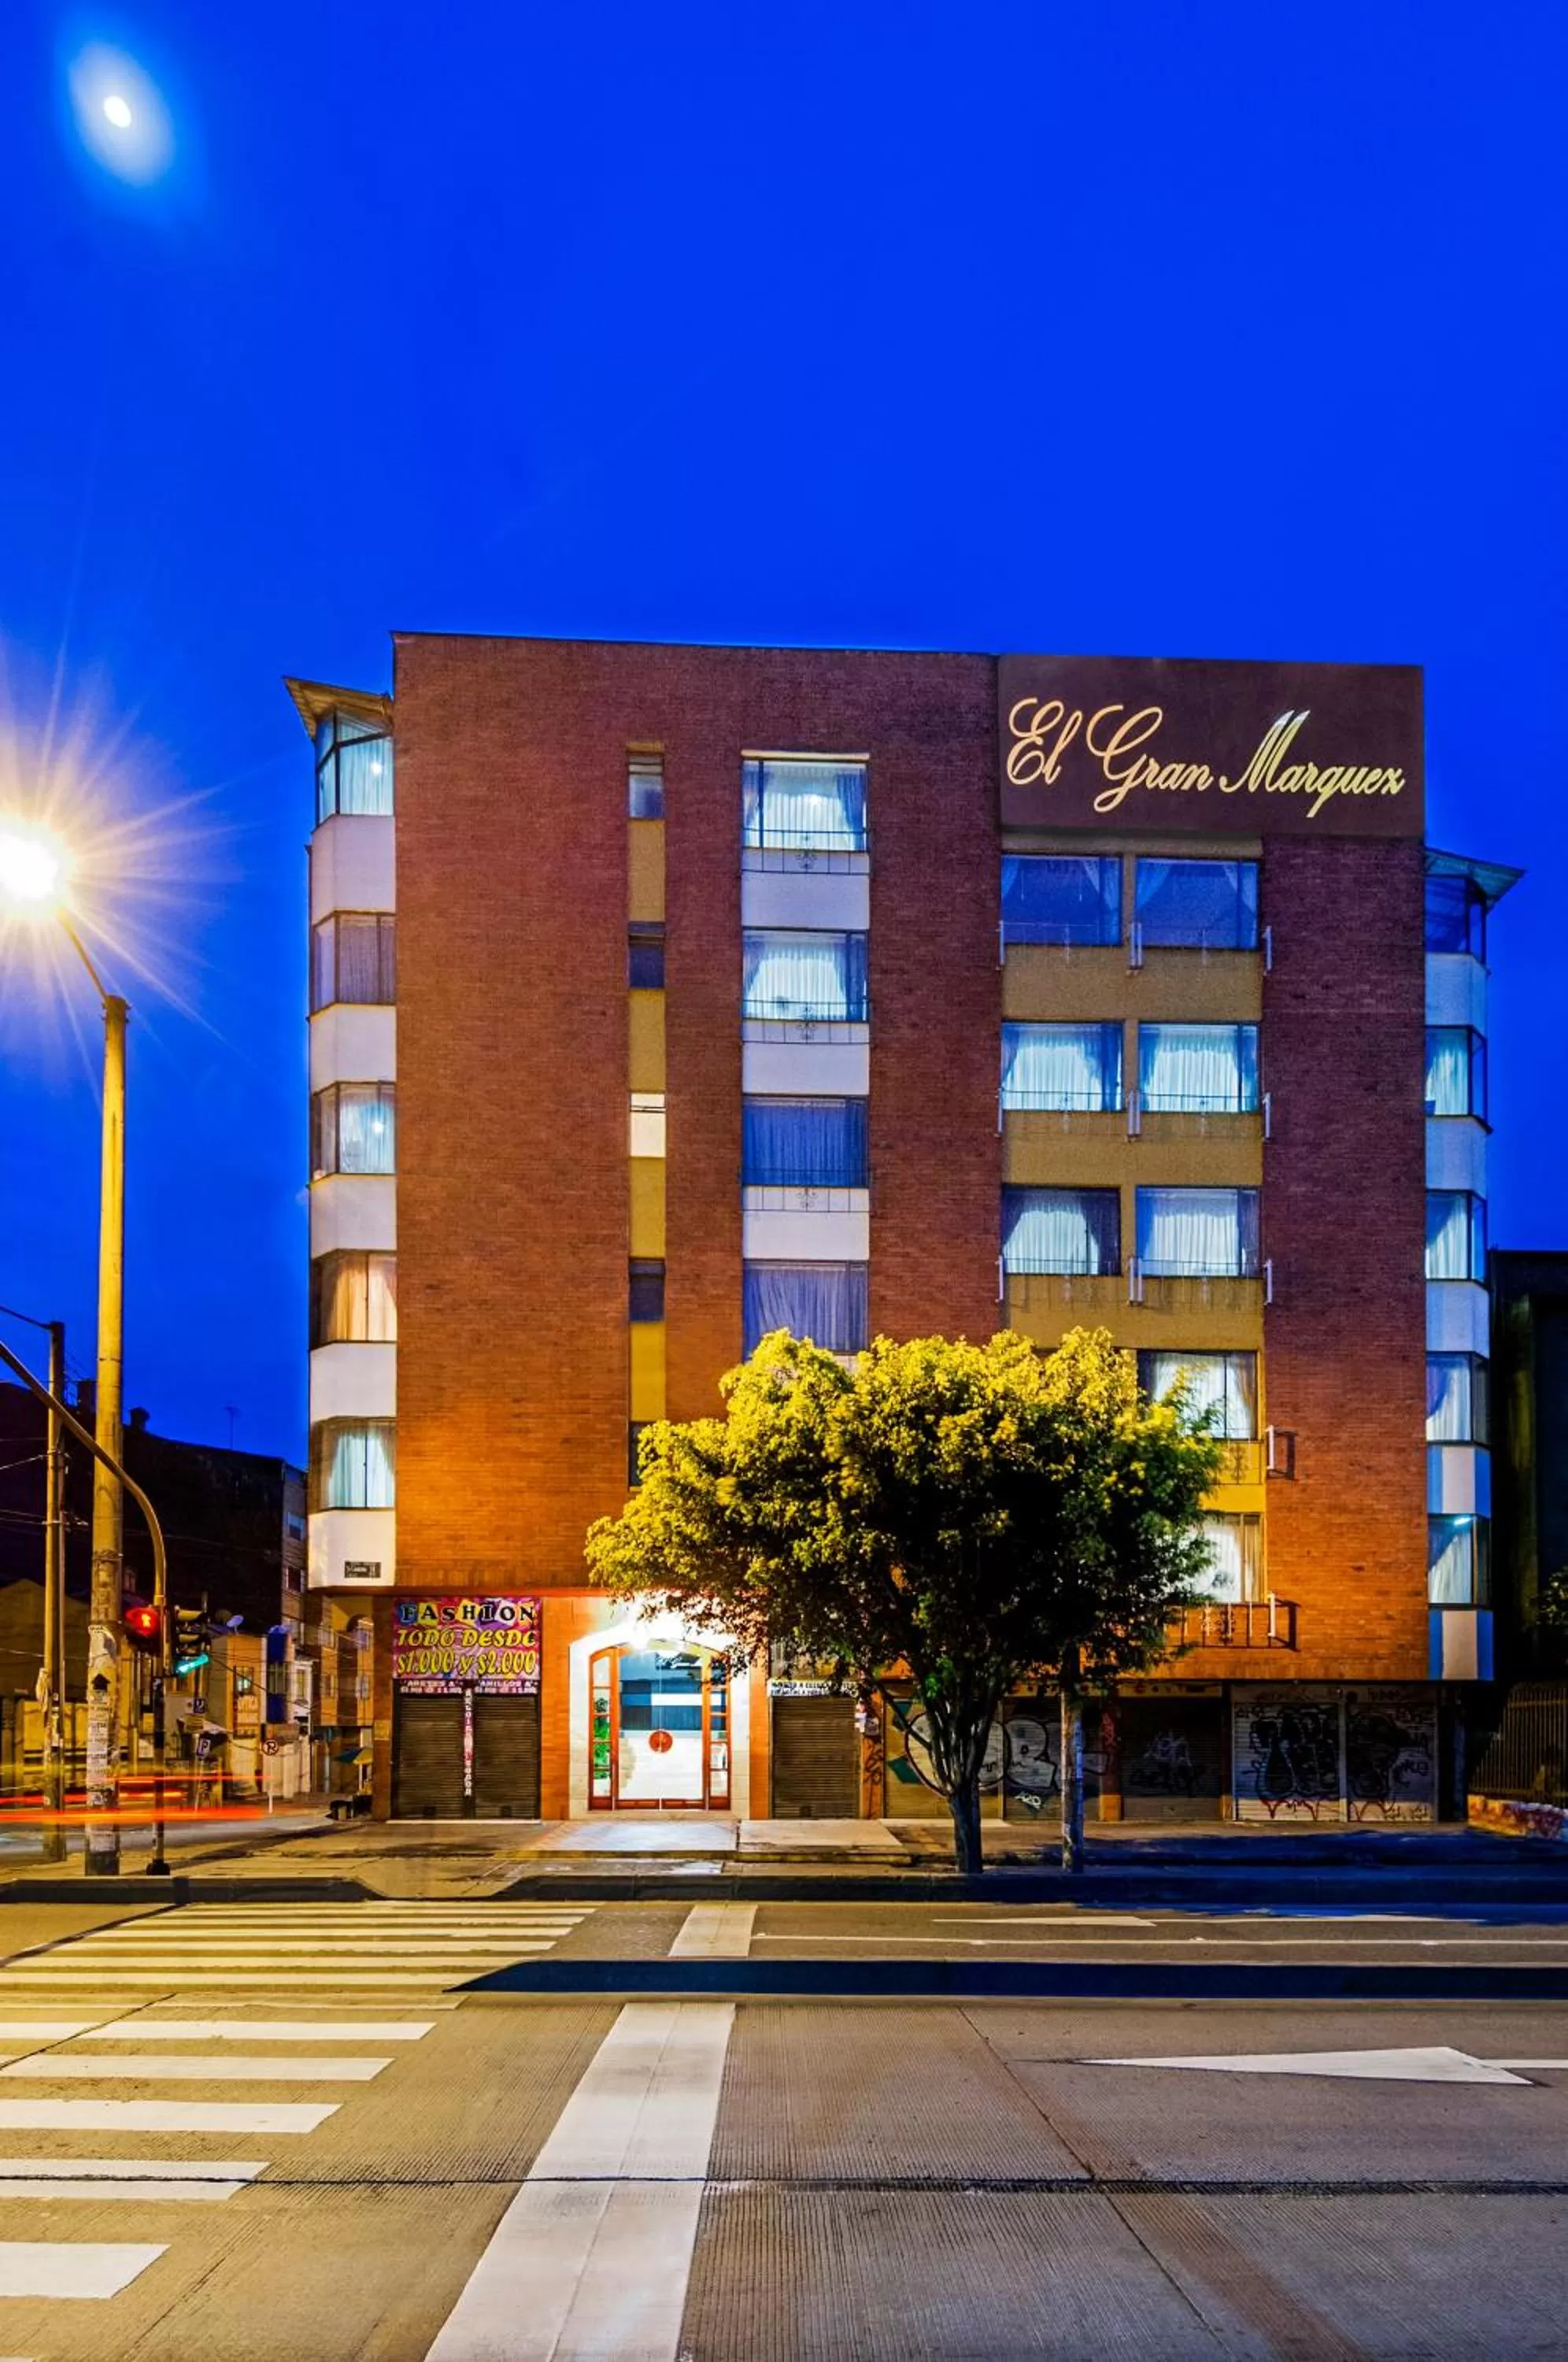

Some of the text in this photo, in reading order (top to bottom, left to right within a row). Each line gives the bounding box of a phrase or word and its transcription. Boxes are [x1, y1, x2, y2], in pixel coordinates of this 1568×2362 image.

[1007, 697, 1082, 785] El
[1086, 705, 1214, 813] Gran
[401, 1604, 534, 1623] FASHION
[397, 1629, 537, 1648] TODO DESDE
